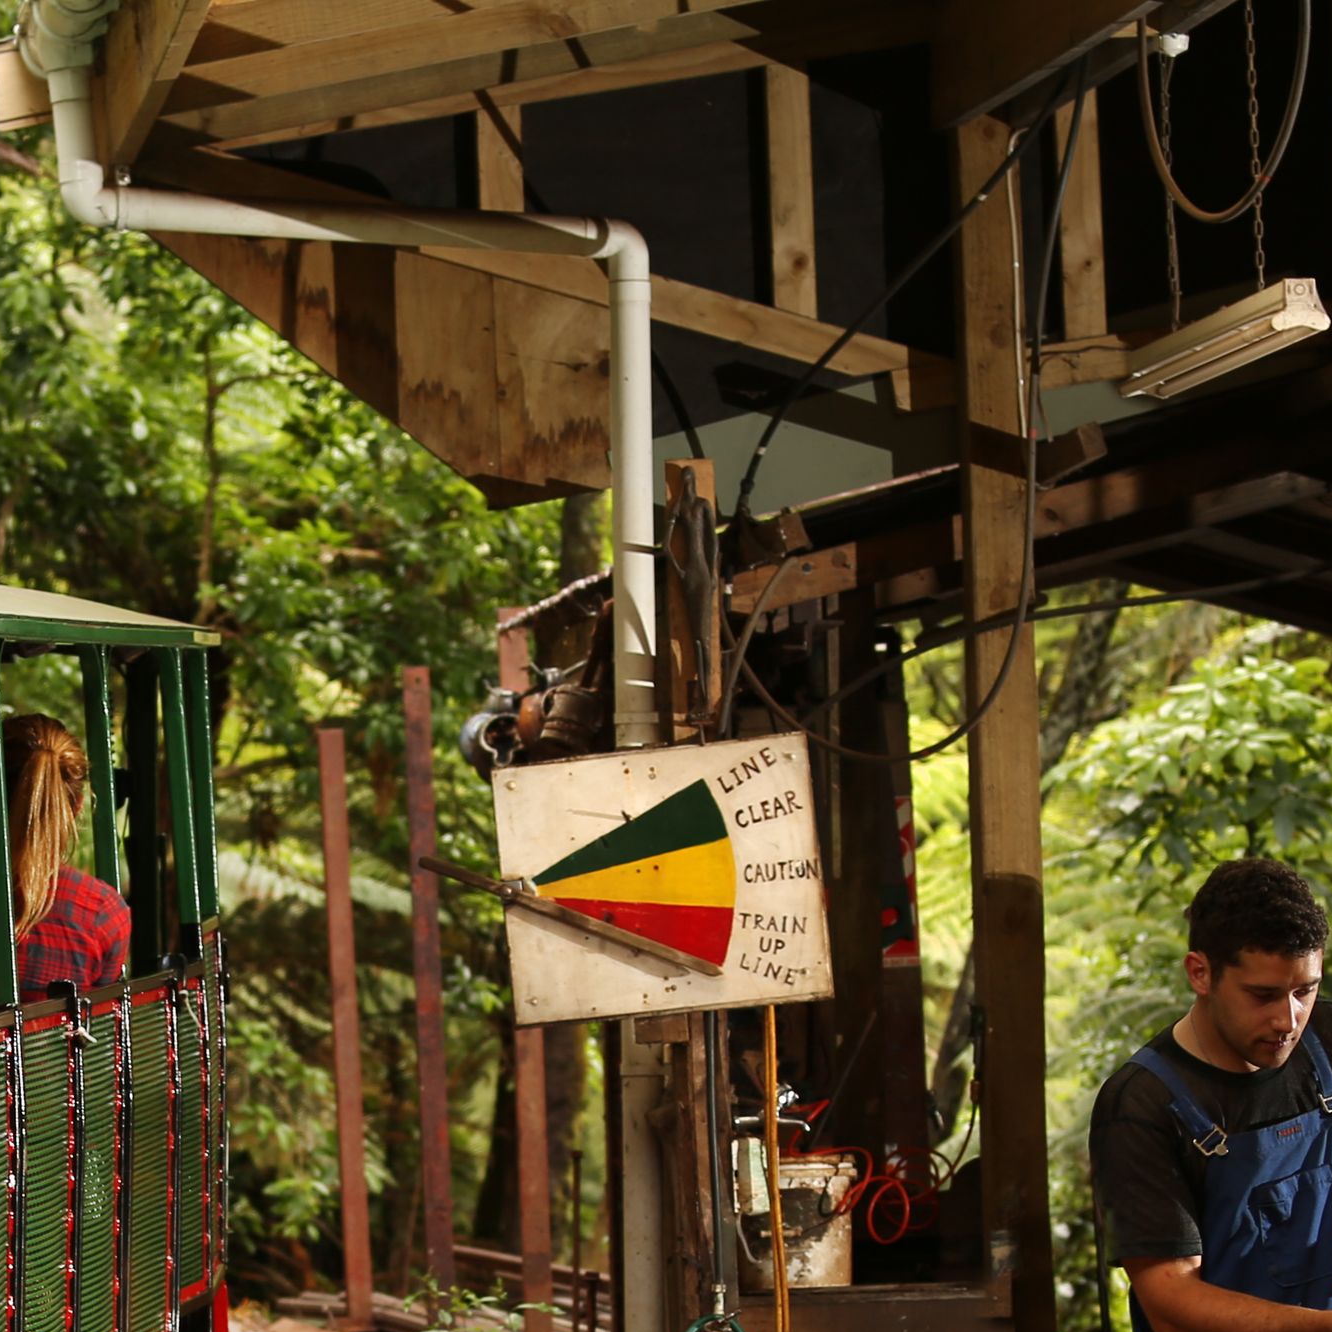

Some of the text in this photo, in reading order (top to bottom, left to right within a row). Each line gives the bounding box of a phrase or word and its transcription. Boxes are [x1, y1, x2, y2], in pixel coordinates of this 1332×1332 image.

[716, 746, 778, 794] LINE
[734, 790, 804, 829] CLEAR
[743, 857, 819, 884] CAUTION
[739, 912, 807, 935] TRAIN
[759, 936, 786, 955] UP
[739, 953, 796, 986] LINE
